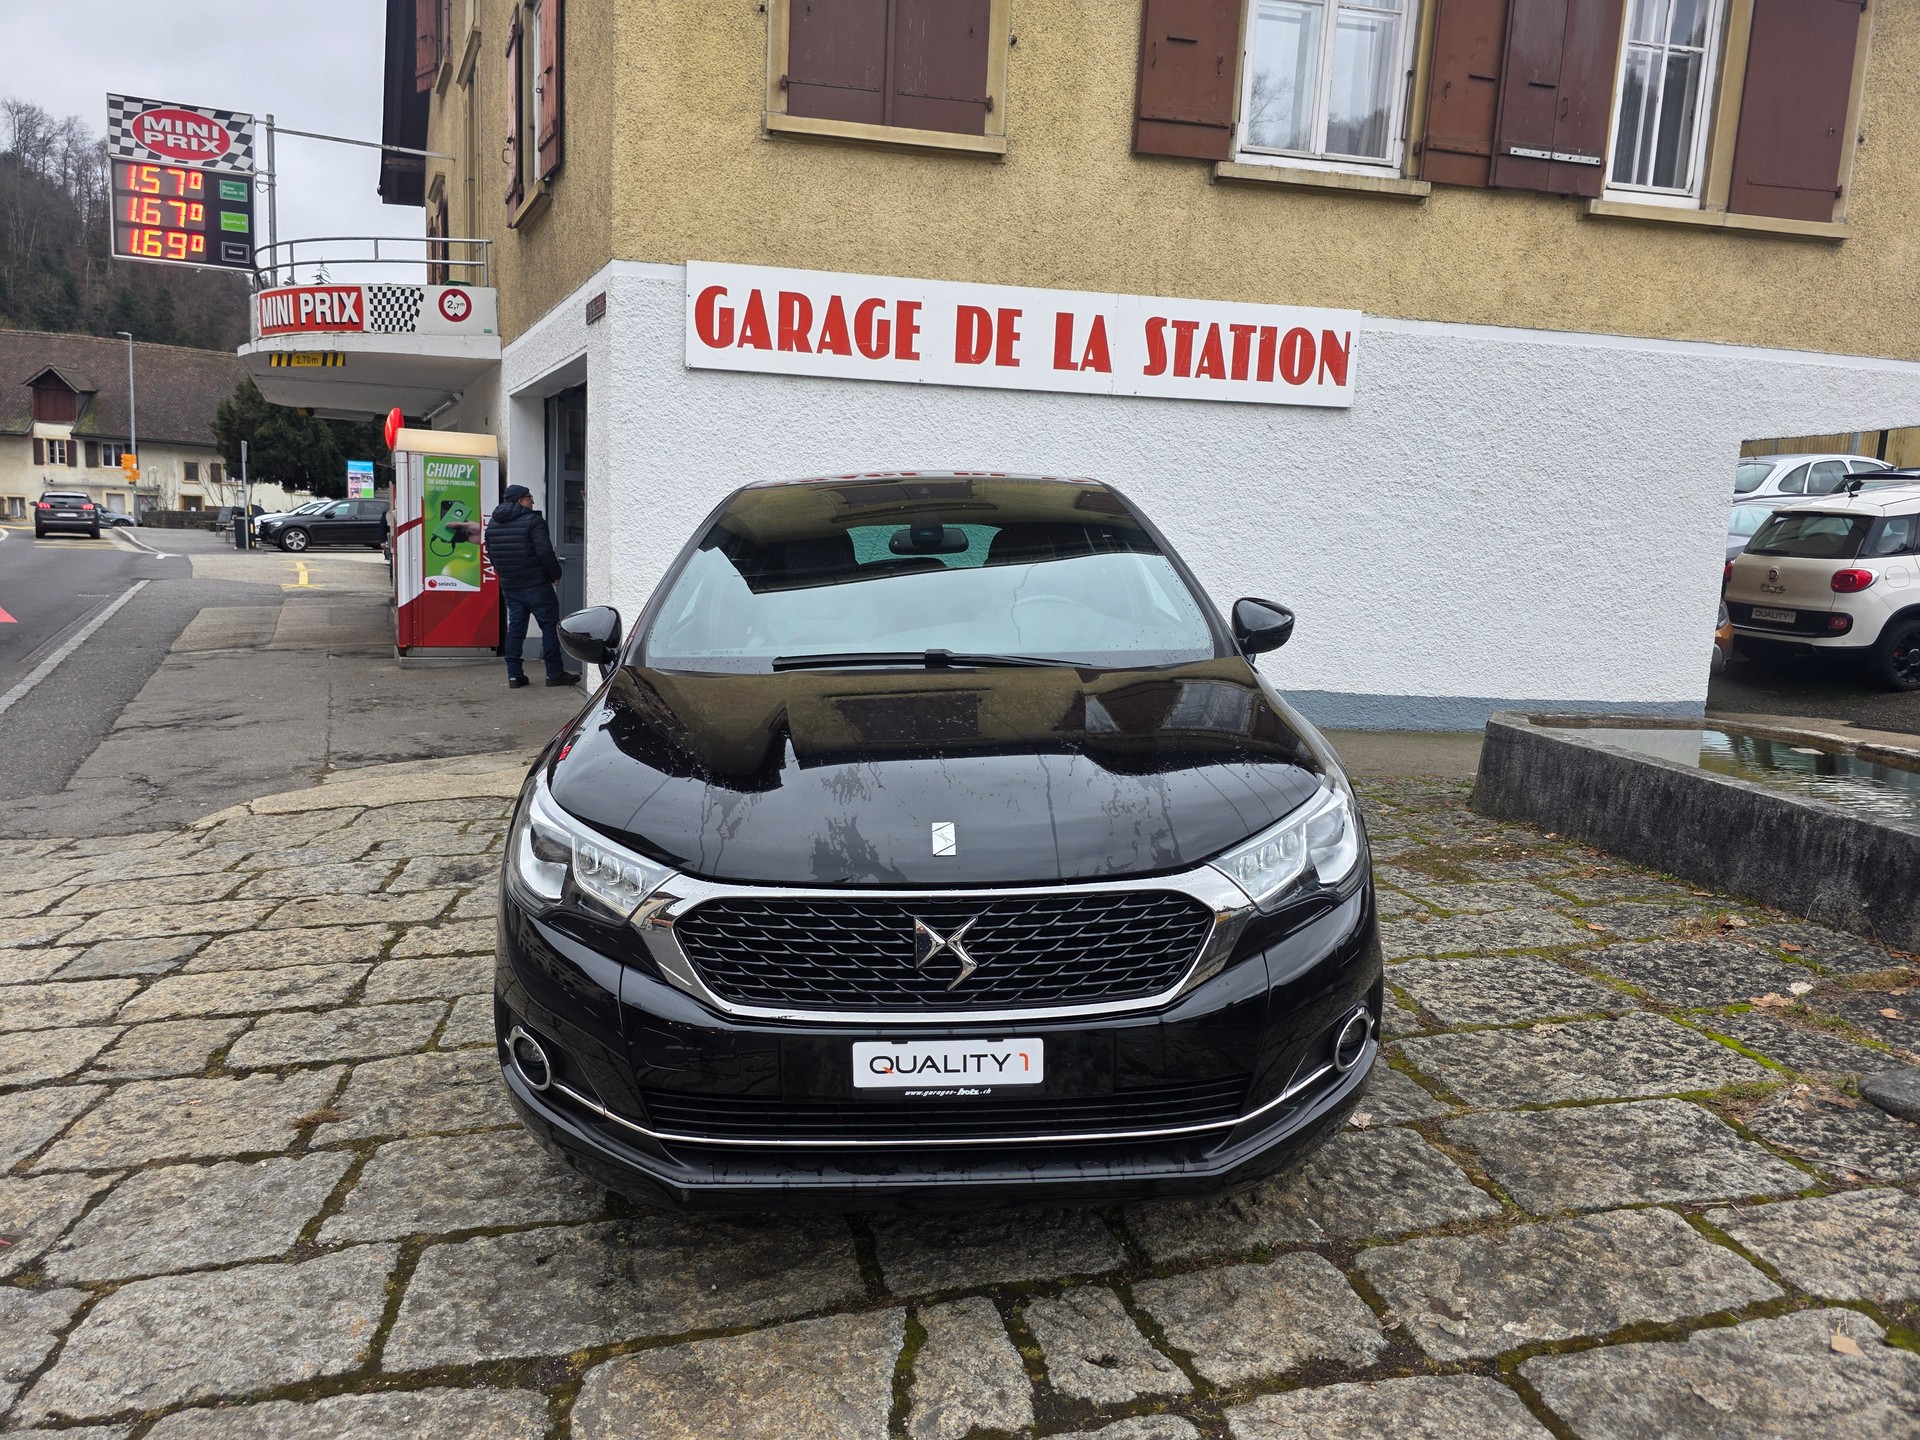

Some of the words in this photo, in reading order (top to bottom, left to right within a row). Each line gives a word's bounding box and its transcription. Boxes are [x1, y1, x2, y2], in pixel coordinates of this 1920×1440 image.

[143, 115, 220, 139] MINI
[144, 131, 221, 154] PRIX
[261, 294, 295, 328] MINI
[300, 291, 360, 325] PRIX
[695, 285, 922, 361] GARAGE
[955, 304, 1023, 367] DE
[1053, 312, 1112, 373] LA
[1143, 316, 1351, 387] STATION
[426, 462, 474, 479] CHIMPY
[1755, 610, 1789, 619] QUALITY
[869, 1053, 1012, 1075] QUALITY
